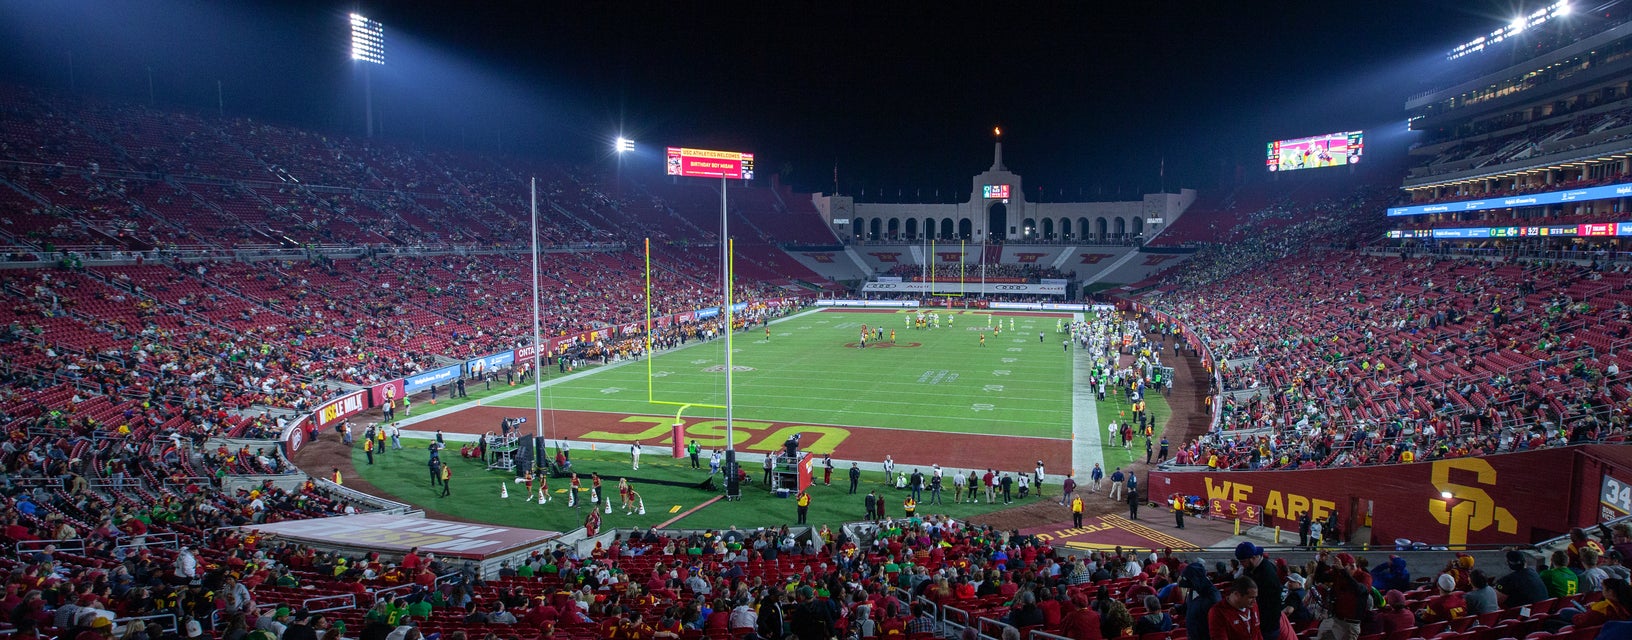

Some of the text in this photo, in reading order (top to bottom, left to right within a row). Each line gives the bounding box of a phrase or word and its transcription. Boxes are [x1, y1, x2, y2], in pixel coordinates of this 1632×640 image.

[1584, 224, 1593, 236] 17
[518, 344, 544, 357] ONTAO
[318, 393, 363, 426] MUSCLE MILK
[577, 415, 851, 455] USC
[1204, 477, 1254, 503] WE
[1263, 489, 1336, 524] ARE
[1605, 479, 1631, 511] 34
[1054, 522, 1116, 539] FIGHT
[387, 611, 397, 625] 6
[609, 626, 617, 638] 7
